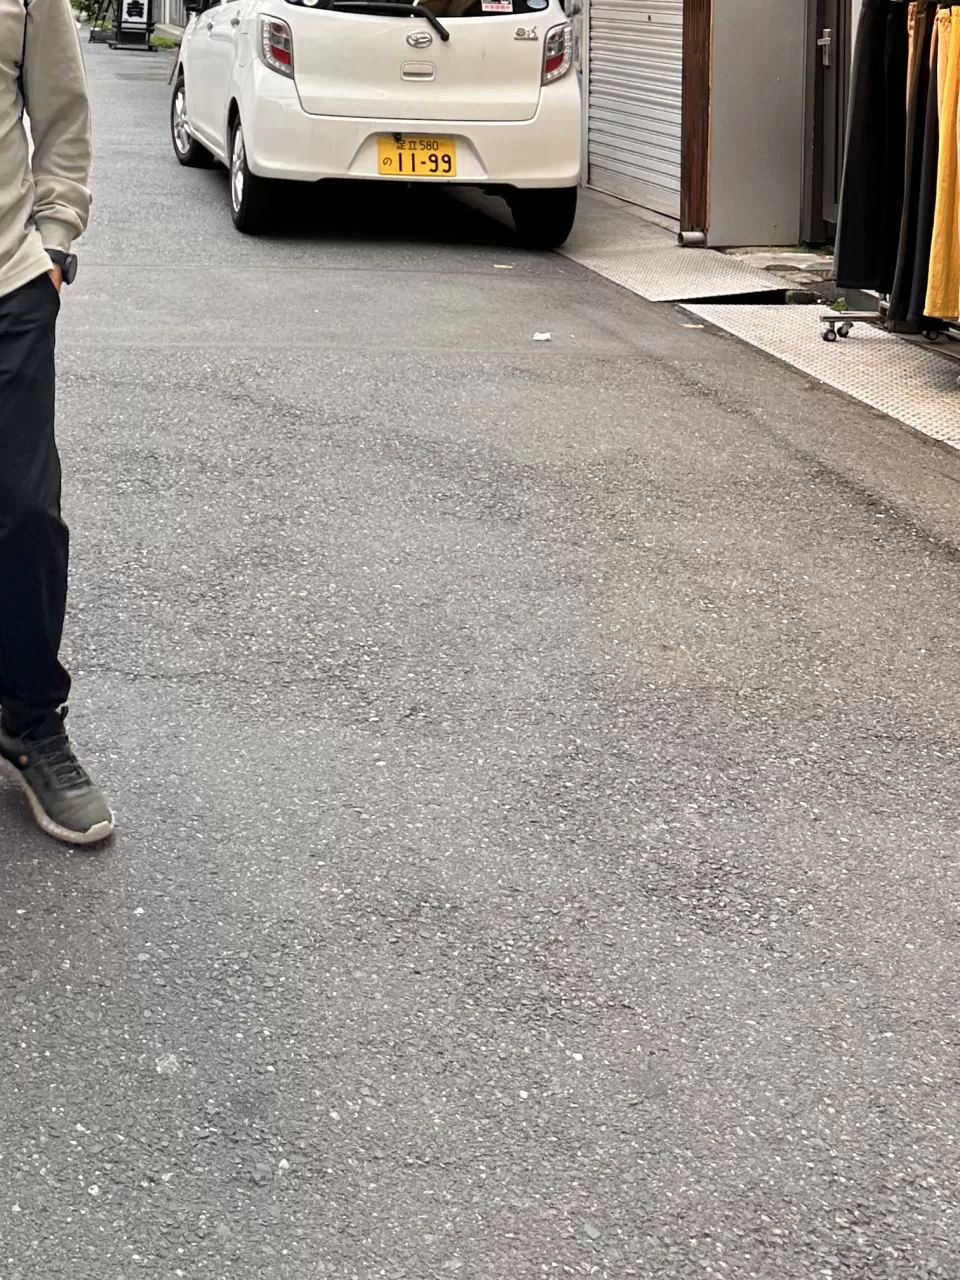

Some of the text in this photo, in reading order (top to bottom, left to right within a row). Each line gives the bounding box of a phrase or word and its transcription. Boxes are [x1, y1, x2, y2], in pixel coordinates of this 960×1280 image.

[396, 140, 439, 151] 足立 580
[382, 152, 452, 173] の 11-99
